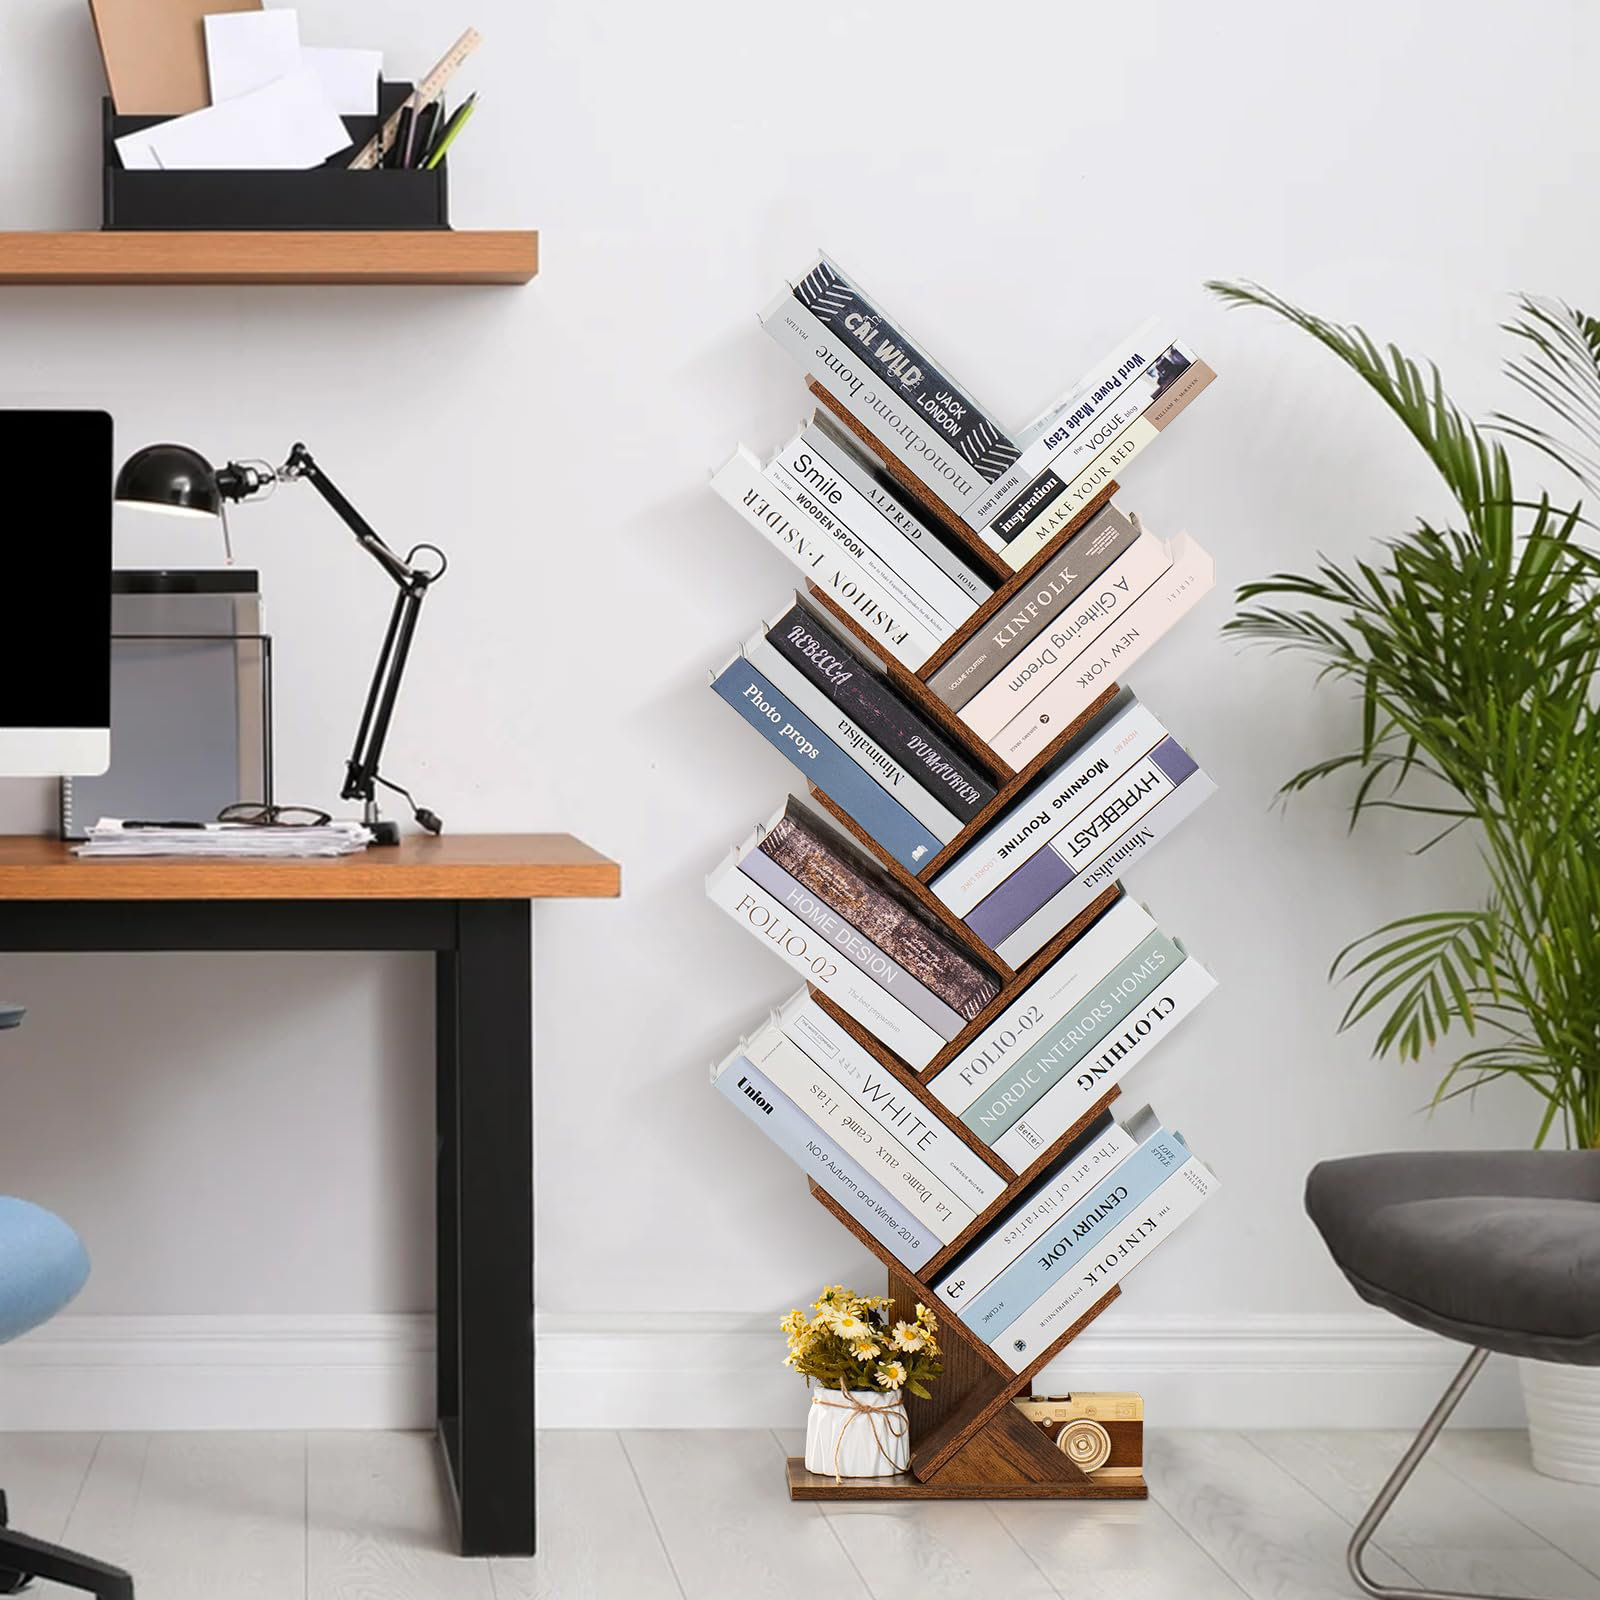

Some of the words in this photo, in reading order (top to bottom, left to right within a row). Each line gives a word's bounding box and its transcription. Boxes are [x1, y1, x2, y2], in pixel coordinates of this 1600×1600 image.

[816, 346, 864, 397] home
[871, 337, 924, 389] WILD
[1117, 353, 1146, 380] Word
[935, 392, 967, 420] JACK
[1091, 375, 1122, 405] Power
[1155, 403, 1174, 421] WILLIAM
[917, 392, 962, 437] LONDON
[1066, 402, 1095, 429] Made
[1073, 446, 1083, 455] the
[1085, 413, 1125, 450] VOGUE
[1124, 405, 1138, 418] blog
[864, 393, 972, 496] monochrome
[1043, 427, 1070, 450] Easy
[793, 454, 842, 504] Smile
[994, 476, 1019, 500] Norman
[1036, 501, 1074, 540] MAKE
[1073, 467, 1111, 500] YOUR
[1110, 441, 1135, 465] BED
[796, 493, 835, 530] WOODEN
[833, 528, 864, 558] SPOON
[977, 498, 997, 516] Lewis
[999, 478, 1058, 533] inspiration
[867, 489, 922, 539] ALPRED
[957, 573, 978, 592] HOME
[1113, 576, 1129, 591] A
[834, 571, 909, 645] FASHION
[992, 567, 1078, 649] KINFOLK
[1050, 592, 1116, 649] Glittering
[787, 625, 853, 685] REBECCA
[1111, 628, 1140, 658] NEW
[948, 673, 967, 690] VOLUME
[965, 654, 987, 675] FOURTEEN
[1008, 648, 1058, 692] Dream
[1076, 658, 1111, 688] YORK
[742, 683, 781, 723] Photo
[778, 723, 819, 759] props
[838, 720, 905, 786] Minimalista
[907, 736, 980, 805] DUMAURIER
[1052, 758, 1109, 809] MORNING
[997, 811, 1051, 859] ROUTINE
[1067, 771, 1160, 858] HYPEBEAST
[1083, 826, 1154, 888] Minimalista
[786, 888, 838, 934] HOME
[735, 894, 837, 984] FOLIO-02
[848, 987, 859, 1000] The
[858, 996, 871, 1009] best
[868, 1007, 900, 1032] preparation
[959, 1006, 1044, 1086] FOLIO-02
[979, 1069, 1040, 1127] NORDIC
[1036, 999, 1113, 1073] INTERIORS
[1110, 950, 1165, 1004] HOMES
[1077, 997, 1175, 1091] CLOTHING
[737, 1076, 774, 1115] Union
[810, 1085, 838, 1115] lias
[862, 1074, 938, 1151] WHITE
[841, 1116, 872, 1143] camé
[1016, 1124, 1041, 1148] Better
[1158, 1144, 1176, 1160] LOVE
[876, 1146, 899, 1169] aux
[950, 1162, 969, 1180] CHRISSIE
[1072, 1164, 1090, 1182] art
[1093, 1143, 1119, 1163] The
[1151, 1148, 1171, 1167] STYLE
[806, 1141, 828, 1162] NO.9
[825, 1161, 858, 1192] Autumn
[857, 1190, 876, 1208] and
[874, 1204, 899, 1229] Winter
[897, 1227, 920, 1249] 2018
[903, 1172, 932, 1203] Dame
[1056, 1184, 1069, 1201] of
[1183, 1171, 1206, 1196] WILLIAMS
[1190, 1170, 1208, 1190] NATHAN
[936, 1202, 952, 1222] La
[1004, 1197, 1058, 1244] libraries
[1072, 1187, 1128, 1241] CENTURY
[1159, 1206, 1170, 1217] THE
[1038, 1237, 1073, 1271] LOVE
[1083, 1218, 1157, 1286] KINFOLK
[982, 1306, 1001, 1323] CLINIC
